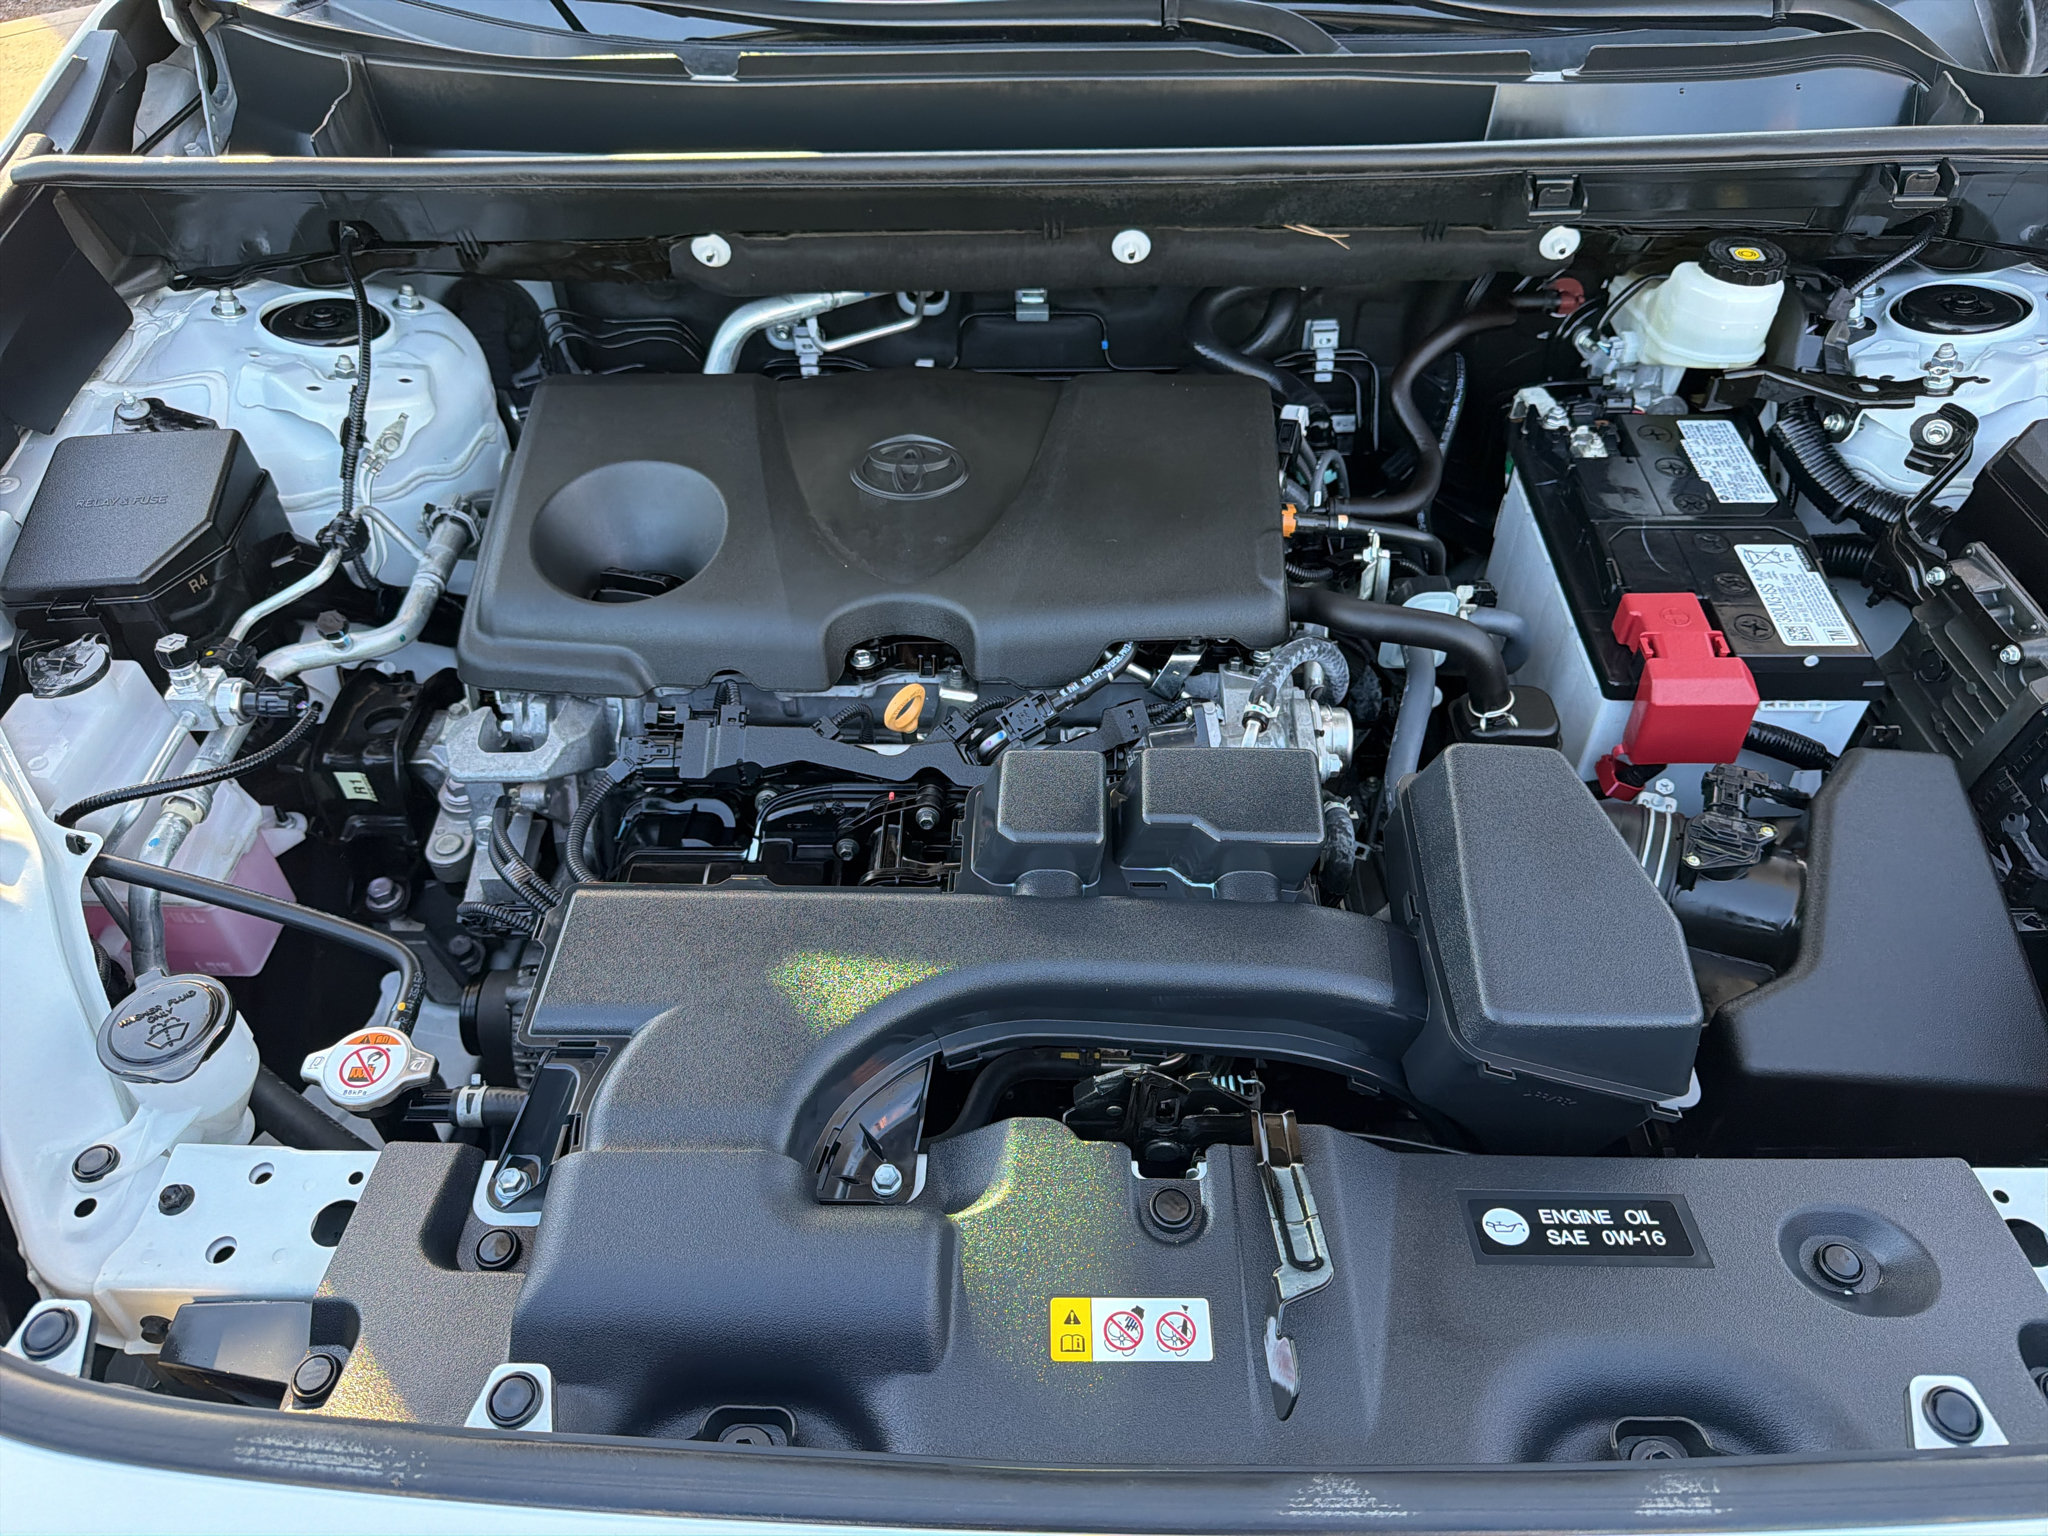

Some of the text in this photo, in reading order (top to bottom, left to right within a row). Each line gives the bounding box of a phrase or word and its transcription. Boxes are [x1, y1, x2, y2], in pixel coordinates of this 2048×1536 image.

[75, 497, 120, 508] RELAY
[132, 495, 168, 505] FUSE
[188, 573, 208, 594] R4
[167, 989, 197, 1007] FLUID
[146, 1006, 174, 1024] ONLY
[1538, 1208, 1660, 1226] ENGINE OIL
[1546, 1229, 1667, 1247] SAE 0W-16
